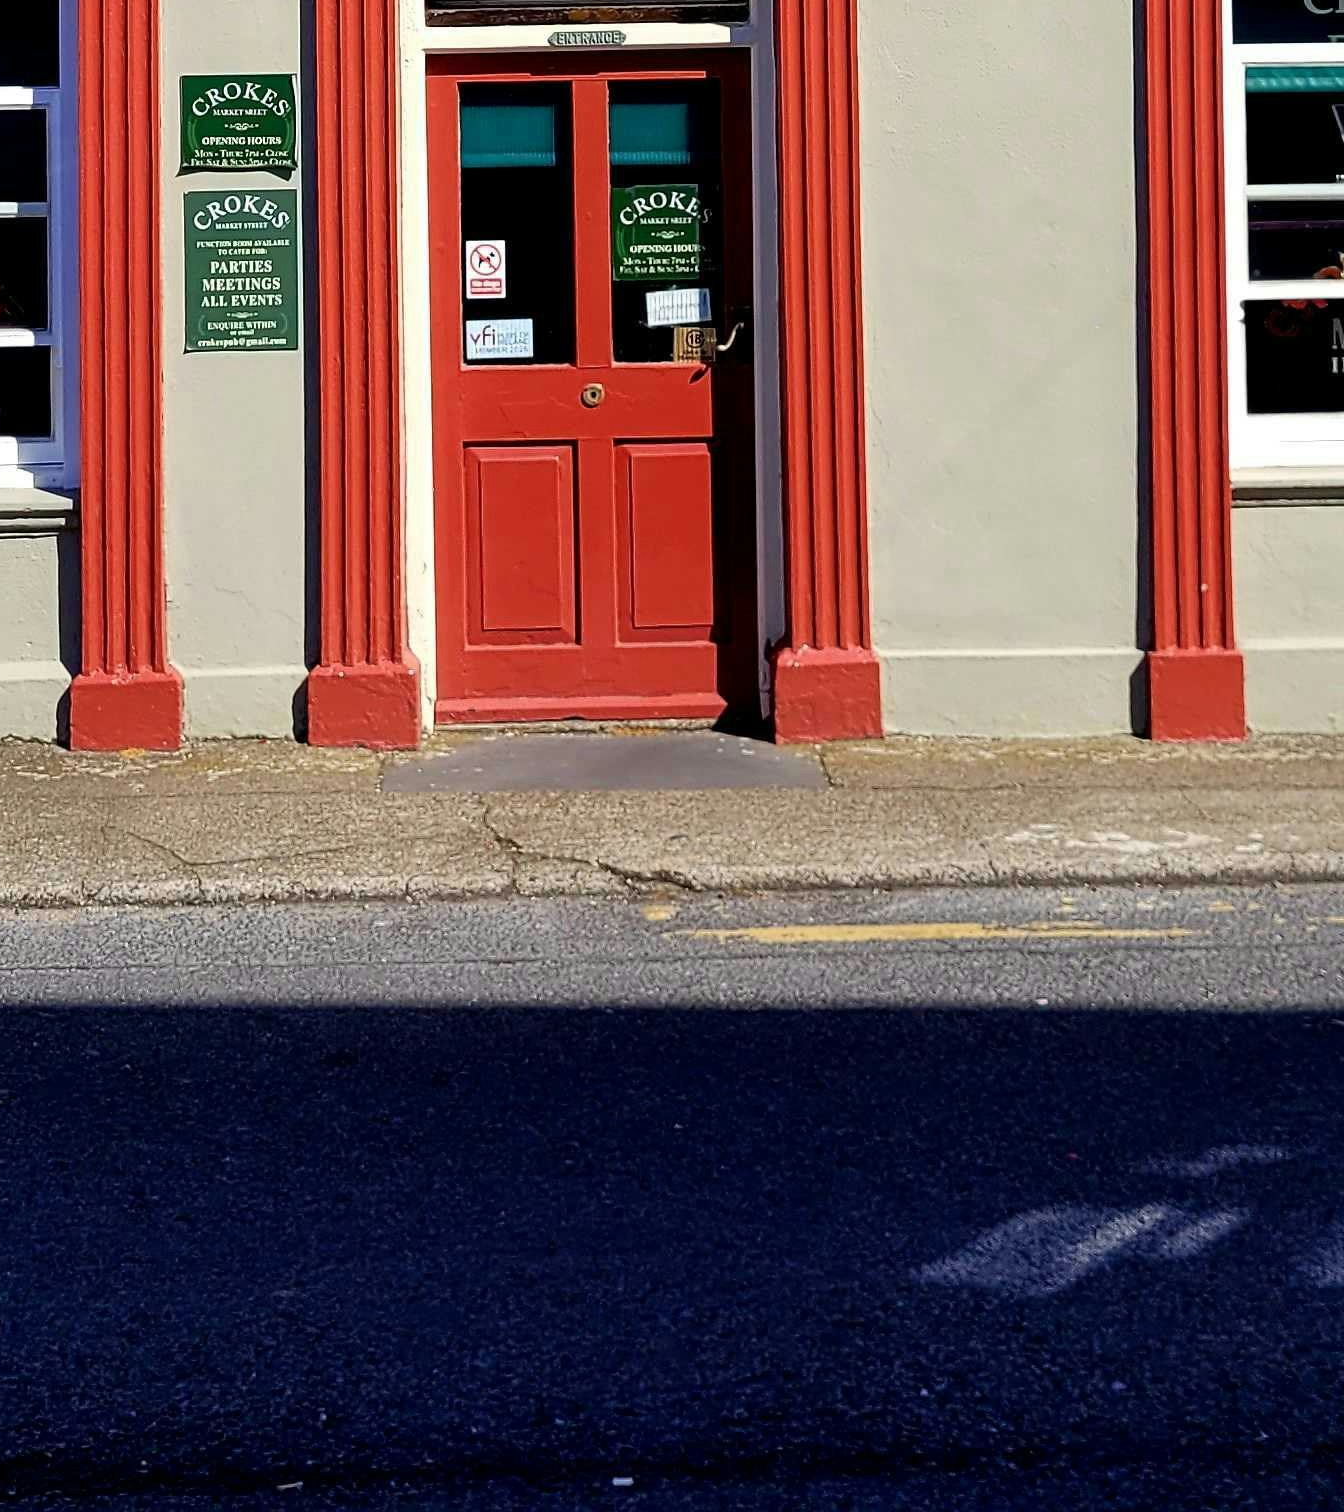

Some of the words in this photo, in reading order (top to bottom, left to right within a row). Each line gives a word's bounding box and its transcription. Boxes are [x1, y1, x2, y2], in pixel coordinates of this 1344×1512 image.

[556, 32, 620, 45] ENTRANCE
[192, 82, 290, 117] CROKES
[201, 136, 246, 146] OPENING
[248, 136, 282, 145] HOURS
[194, 195, 290, 230] CROKES
[619, 191, 712, 225] CROKES
[196, 240, 232, 248] FUNCTION
[629, 245, 672, 253] OPENING
[210, 260, 273, 273] PARTIES
[202, 277, 281, 291] MEETINGS
[201, 295, 227, 307] ALL
[231, 294, 282, 306] EVENTS
[207, 321, 244, 331] ENQUIRE
[245, 321, 277, 329] WITHIN
